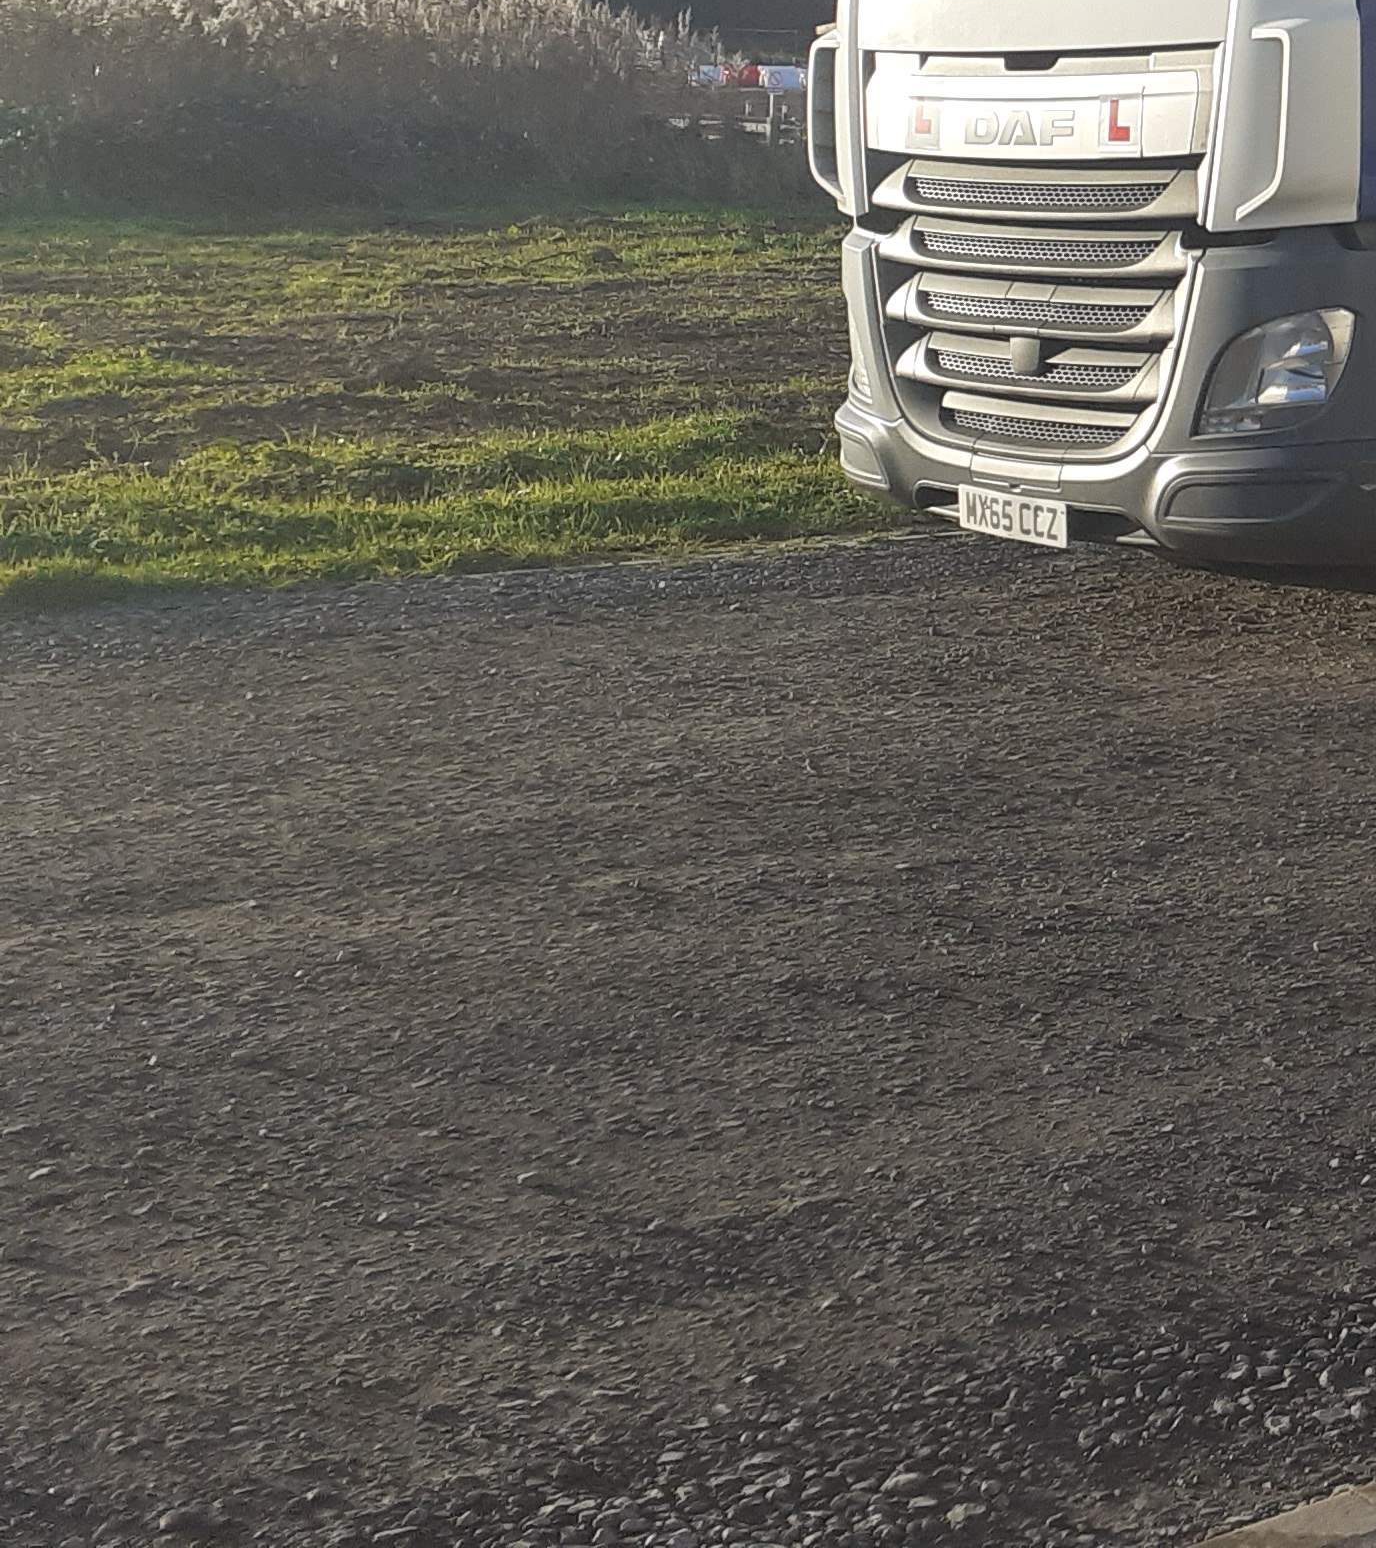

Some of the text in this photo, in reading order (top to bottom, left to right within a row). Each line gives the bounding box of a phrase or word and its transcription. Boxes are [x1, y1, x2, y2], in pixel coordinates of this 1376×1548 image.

[964, 110, 1075, 146] DAF
[1108, 99, 1130, 142] L
[966, 491, 1058, 541] MX65 CCZ
